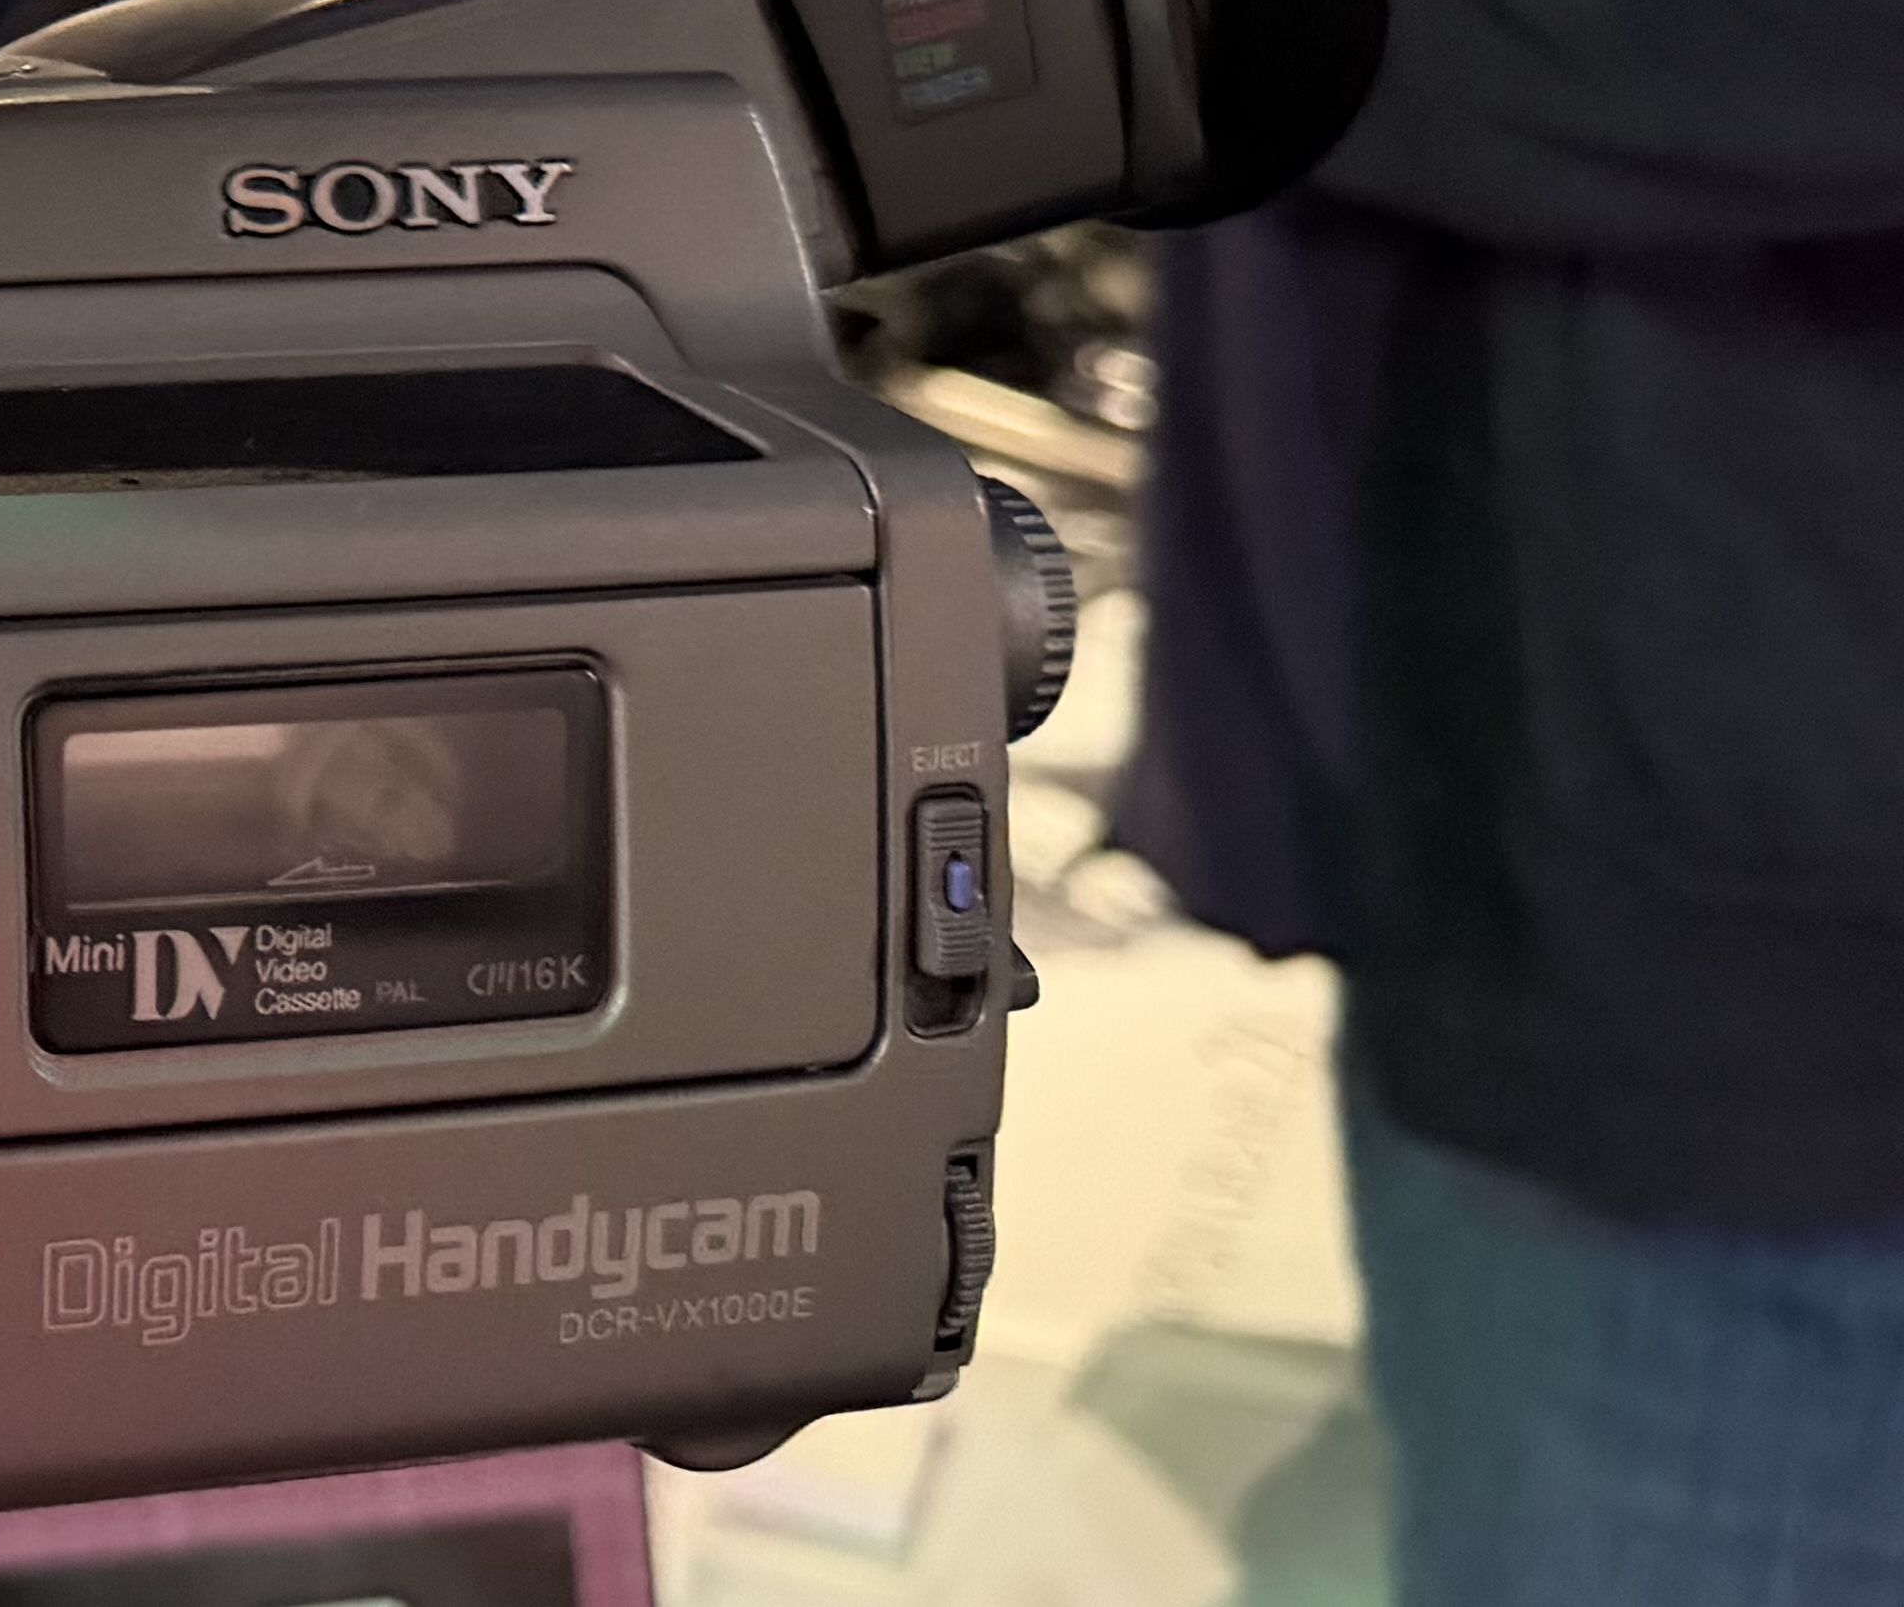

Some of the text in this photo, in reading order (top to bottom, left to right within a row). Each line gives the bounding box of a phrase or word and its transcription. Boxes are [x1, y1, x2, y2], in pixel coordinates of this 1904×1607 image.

[222, 159, 575, 237] SONY
[911, 740, 981, 772] EJECT
[255, 923, 334, 955] Digital
[45, 925, 252, 1022] Mini DV
[255, 958, 328, 984] Video
[254, 987, 363, 1016] Cassette
[375, 979, 428, 1003] PAL
[42, 1189, 821, 1347] Digital Handycam
[558, 1287, 819, 1344] DCR-VX1000E
